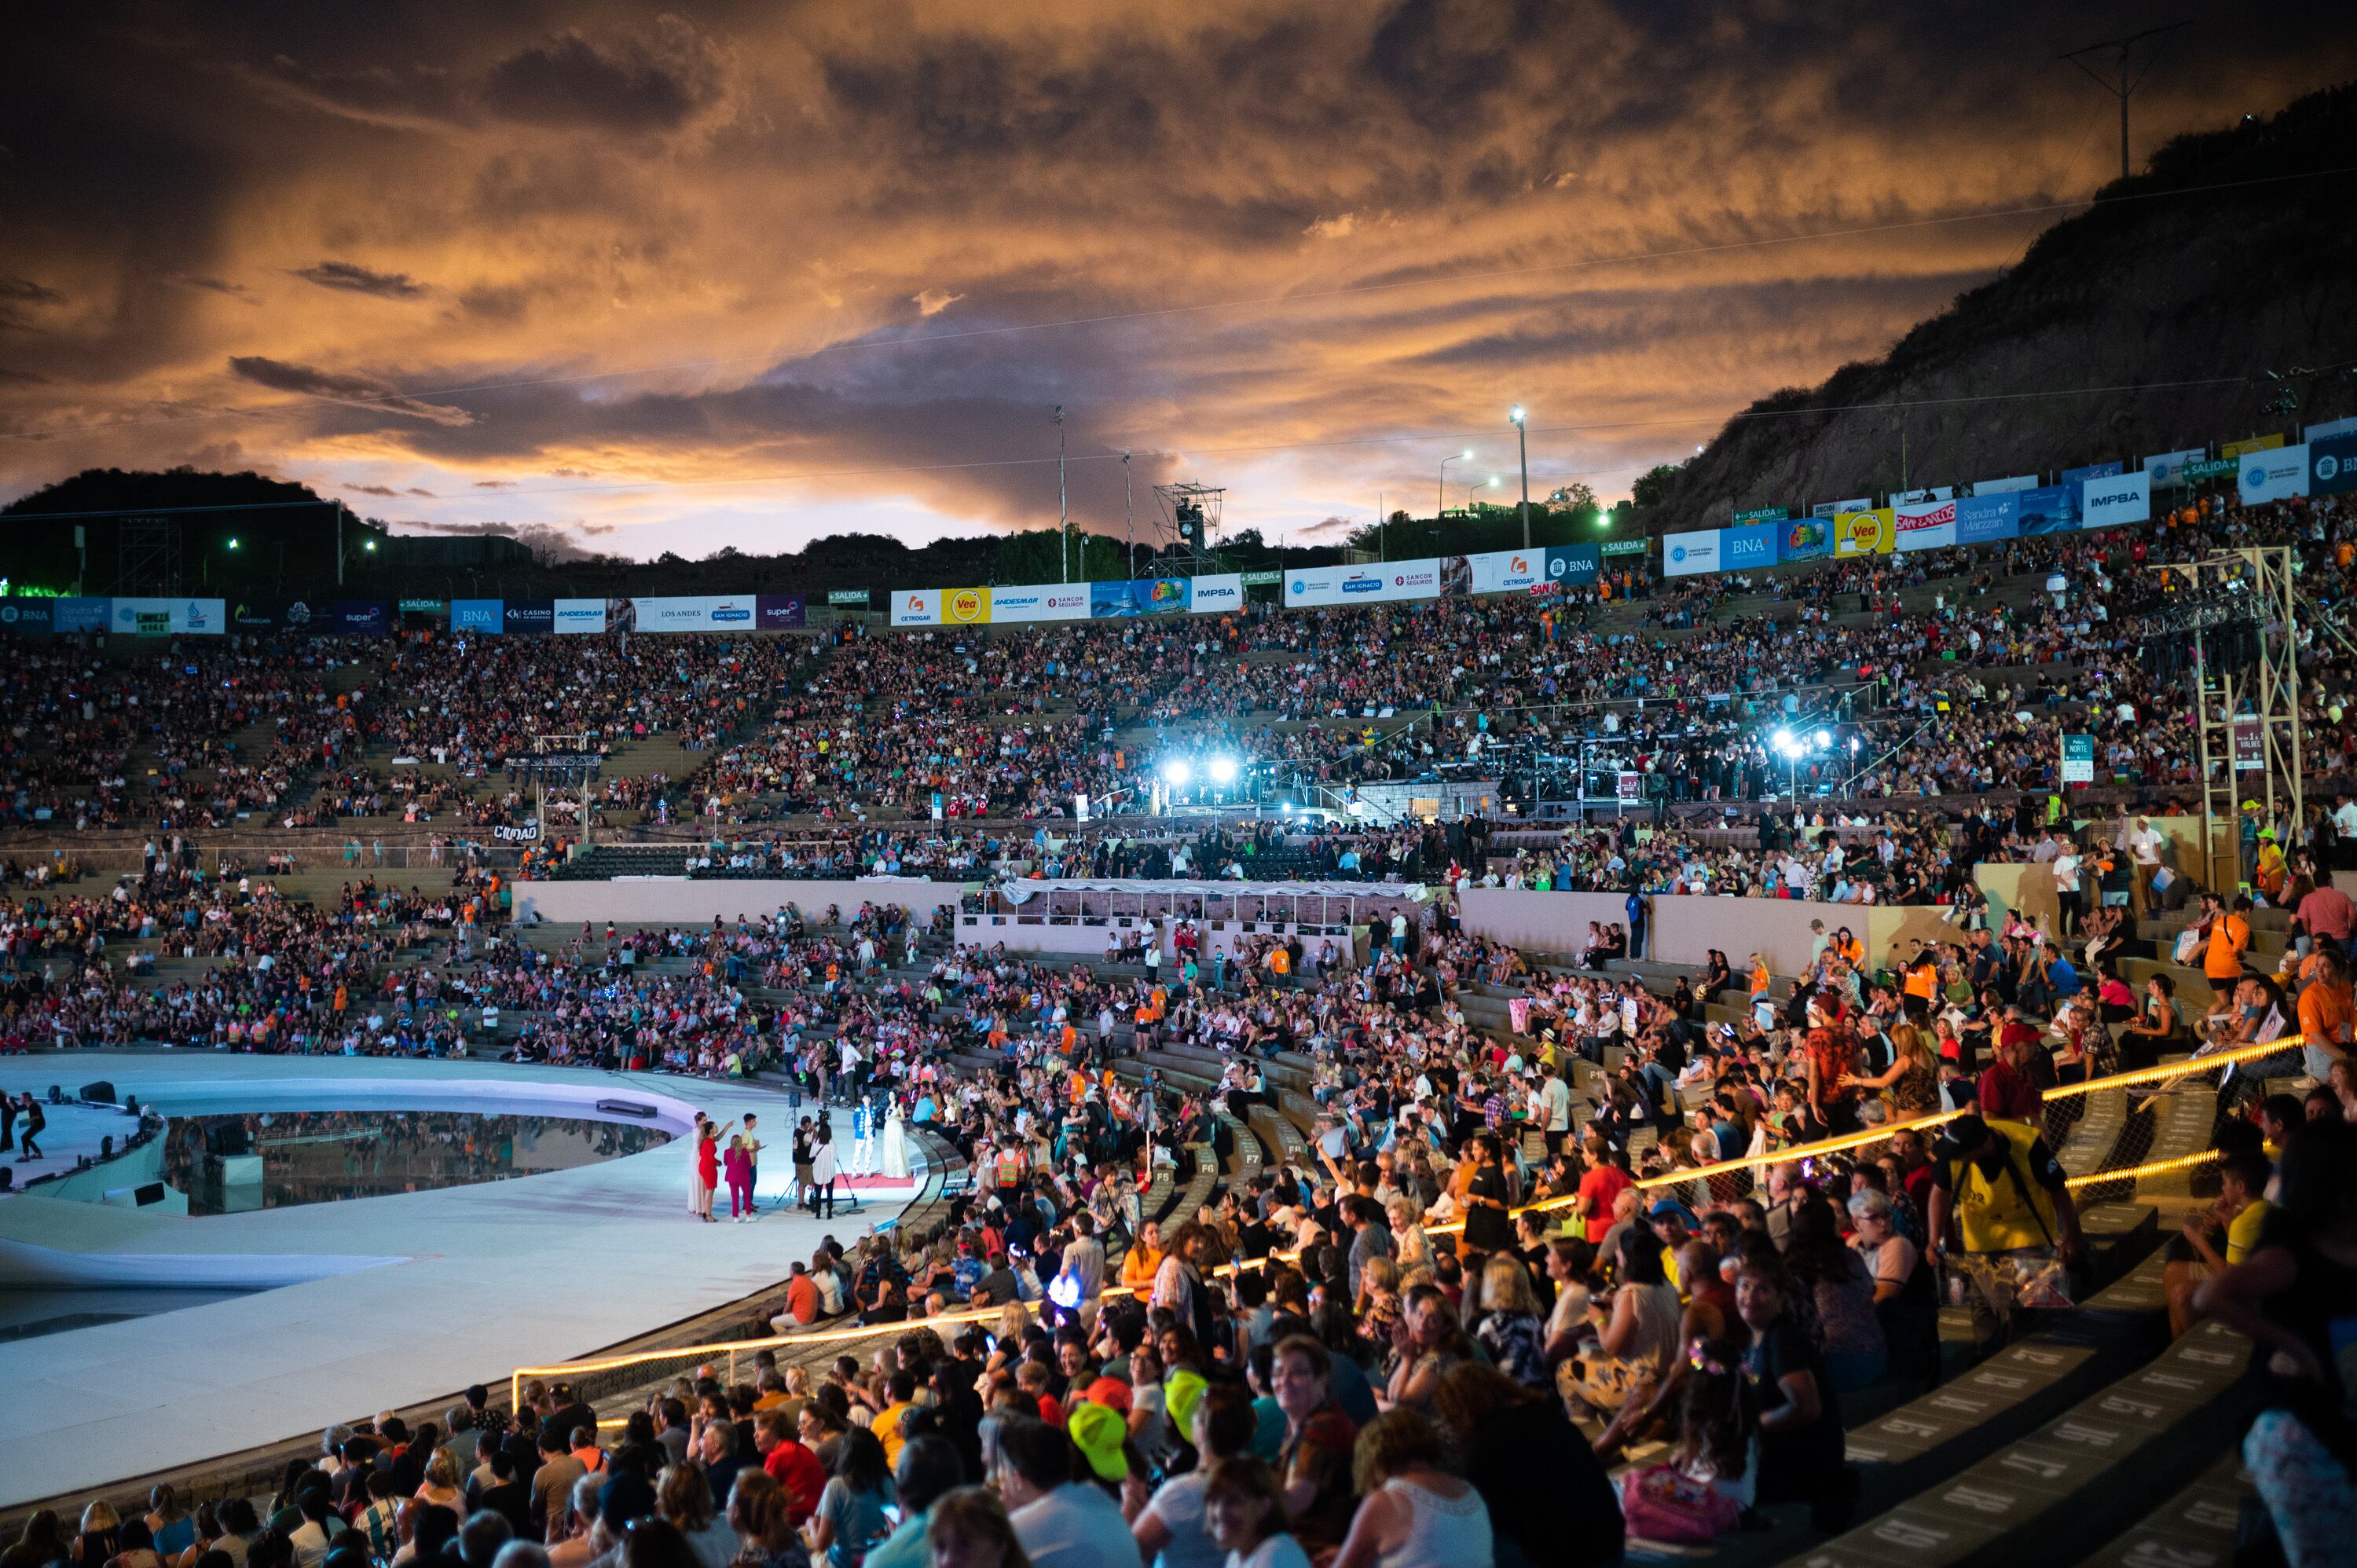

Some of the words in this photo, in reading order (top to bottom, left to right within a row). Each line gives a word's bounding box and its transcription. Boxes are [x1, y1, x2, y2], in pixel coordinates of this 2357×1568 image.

[2191, 460, 2229, 474] SALIDA
[2091, 492, 2139, 507] IMPSA
[1749, 509, 1776, 519] SALIDA
[1964, 507, 1996, 520] Sandra
[1964, 518, 2003, 531] Marzzan
[1853, 526, 1875, 537] Vea
[1608, 541, 1639, 551] SALIDA
[1732, 538, 1765, 554] BNA
[1570, 560, 1593, 572] BNA
[1247, 572, 1274, 581] SALIDA
[1198, 588, 1235, 598] IMPSA
[1530, 583, 1549, 595] SAN
[957, 599, 976, 609] Vea
[22, 610, 49, 621] BNA
[346, 614, 372, 622] super
[463, 610, 491, 621] BNA
[767, 608, 791, 617] super
[494, 826, 537, 841] CIUDAD
[1289, 1145, 1301, 1154] F8
[1246, 1155, 1259, 1164] F7
[1202, 1164, 1214, 1173] F6
[2011, 1349, 2064, 1365] 12
[1974, 1372, 2029, 1388] 13
[2099, 1395, 2164, 1418] 15
[1881, 1419, 1941, 1438] 15
[2000, 1453, 2068, 1478] 17
[1942, 1486, 2017, 1513] 18
[1872, 1519, 1950, 1548] 19
